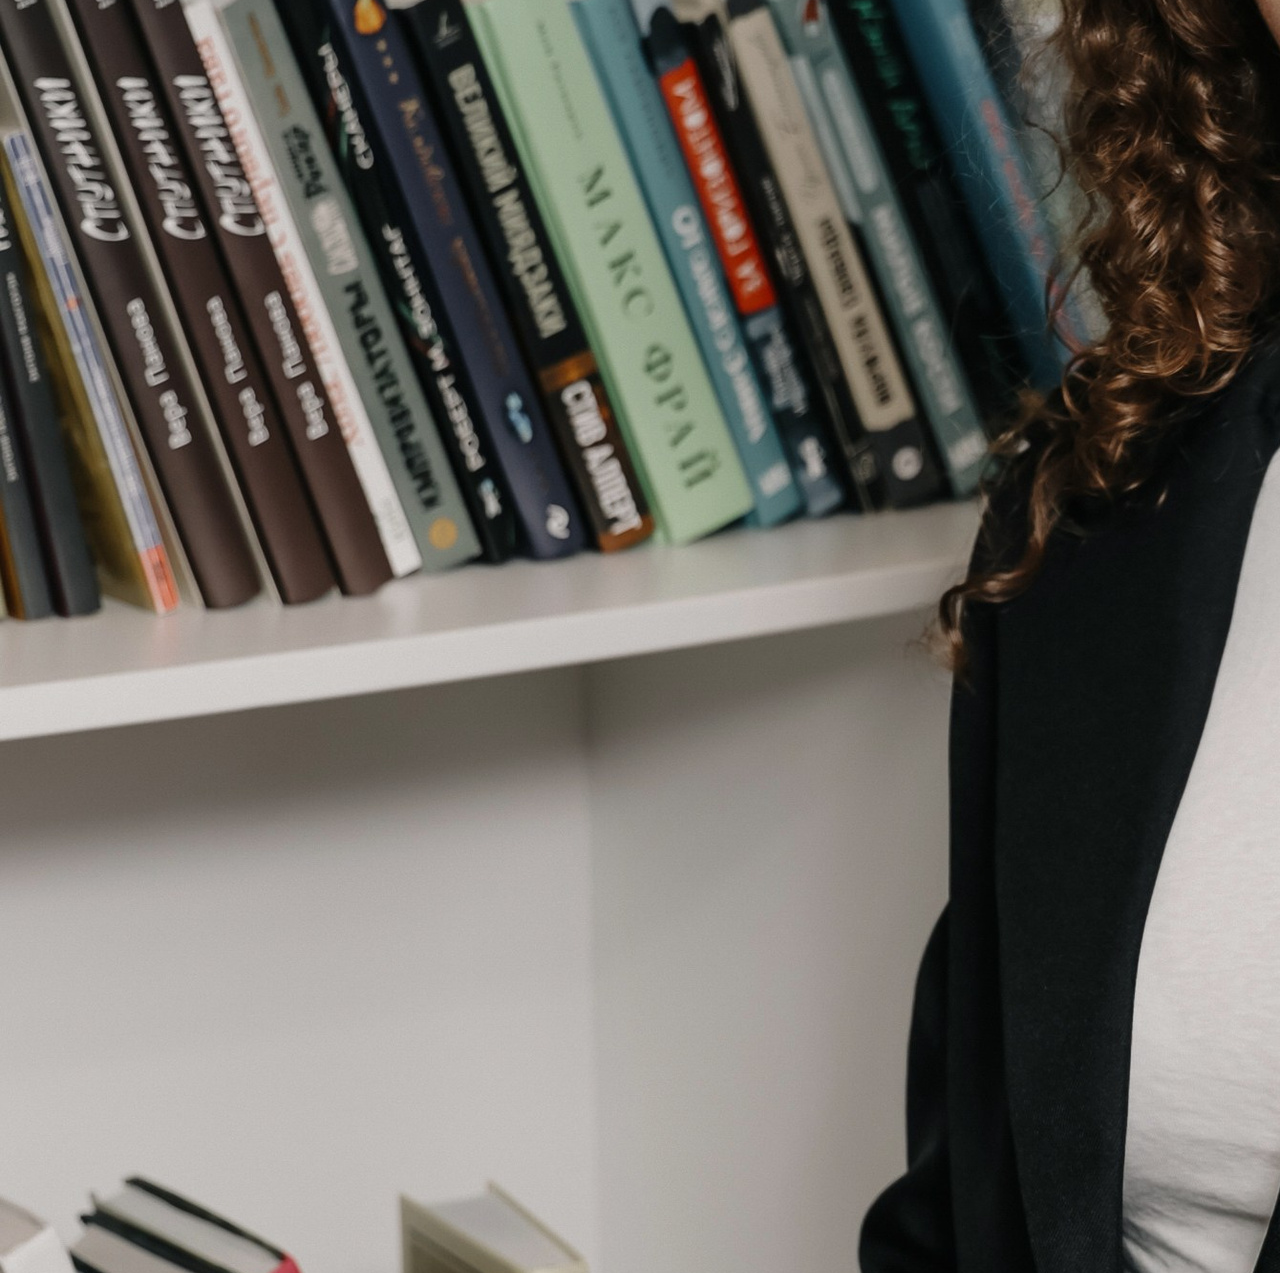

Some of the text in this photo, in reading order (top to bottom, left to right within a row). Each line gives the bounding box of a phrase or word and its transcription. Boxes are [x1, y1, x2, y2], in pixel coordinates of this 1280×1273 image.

[318, 42, 374, 170] СКАНЕРЫ
[448, 63, 517, 192] ВЕЛИКИЙ
[382, 222, 438, 340] ЗОННТАГ
[579, 166, 720, 490] МАКС ФРАЙ
[127, 297, 193, 450] Вера Панова
[206, 295, 270, 448] Вера Панова
[264, 289, 330, 442] Вера Панова
[438, 373, 486, 472] РОБЕРТ
[561, 379, 607, 458] СТИВ
